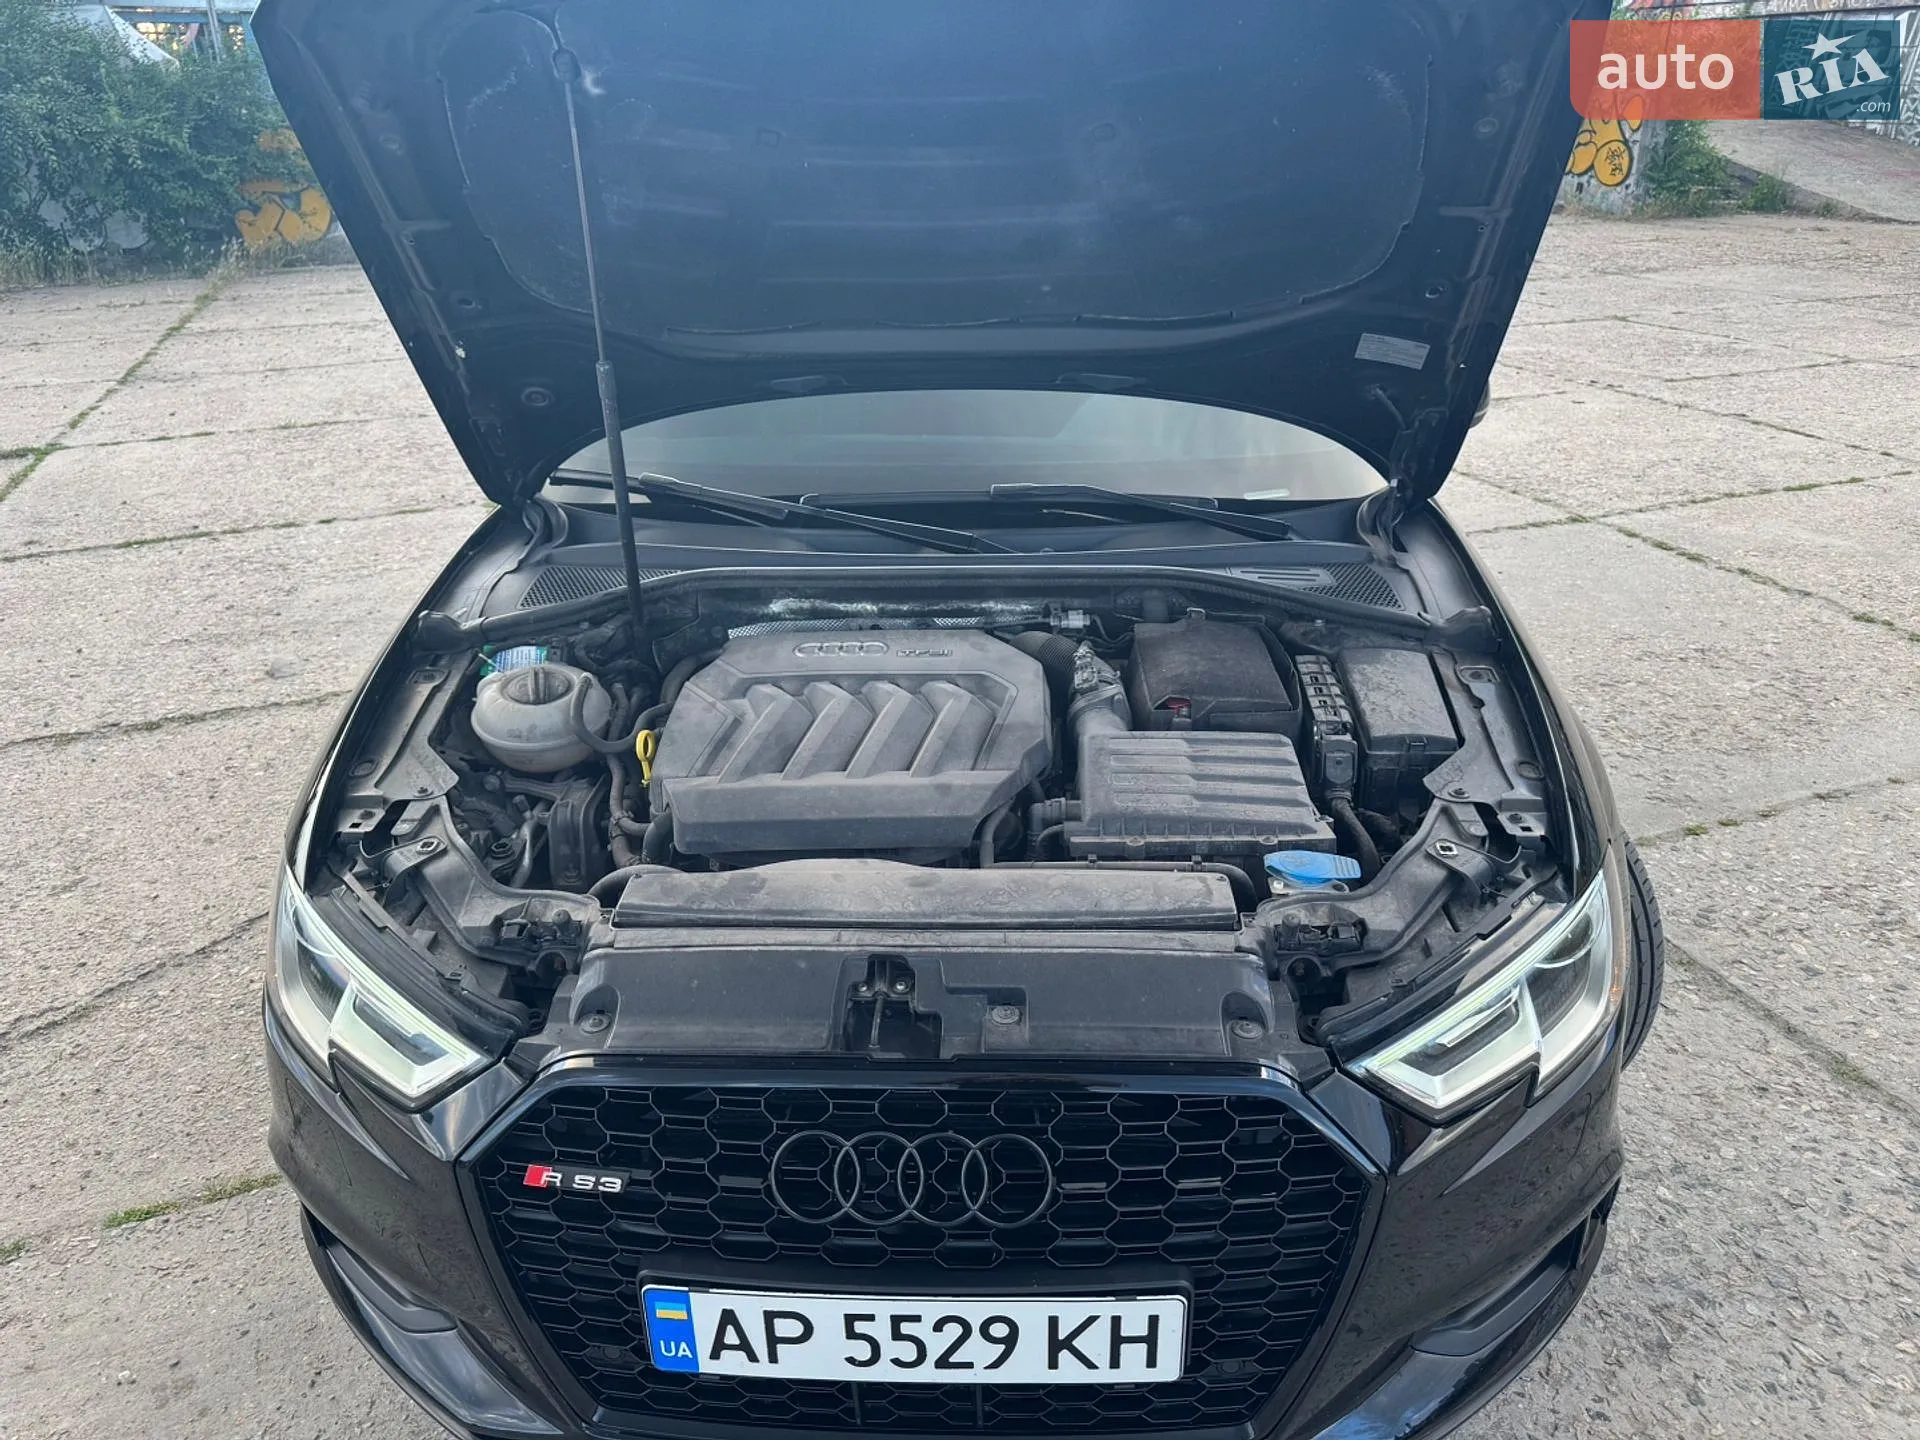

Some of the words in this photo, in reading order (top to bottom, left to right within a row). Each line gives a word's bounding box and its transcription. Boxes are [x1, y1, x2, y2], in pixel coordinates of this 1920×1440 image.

[660, 1339, 693, 1359] UA
[709, 1308, 814, 1364] AP
[843, 1313, 1020, 1370] 5529
[1048, 1314, 1160, 1370] KH
